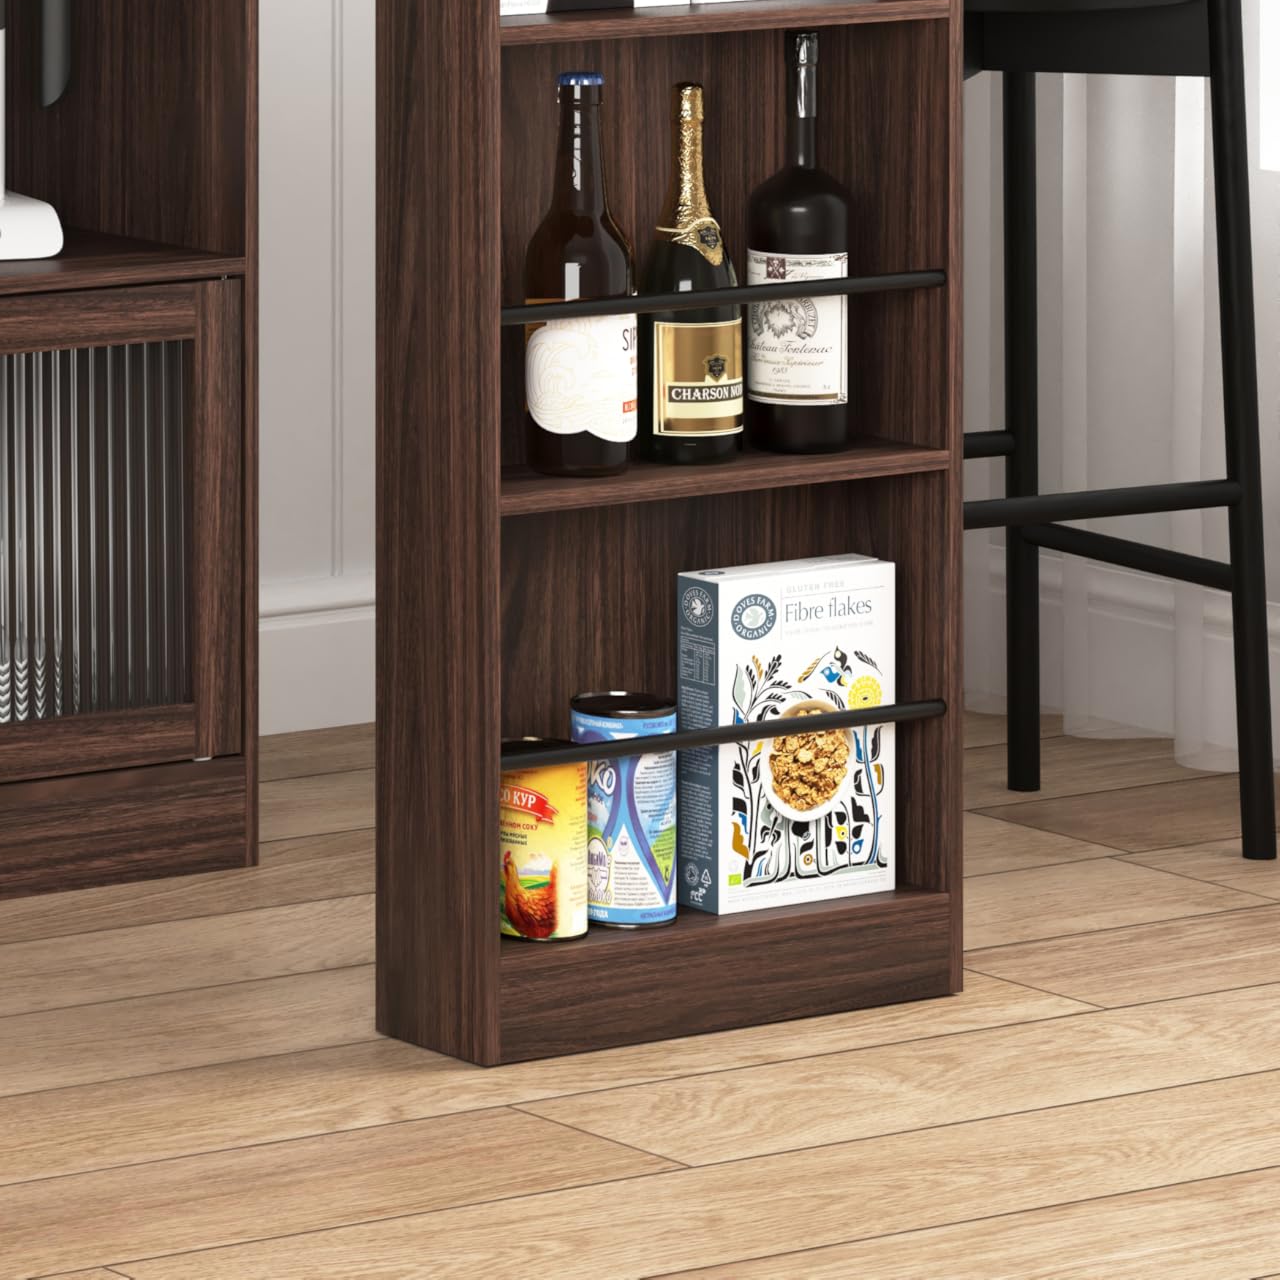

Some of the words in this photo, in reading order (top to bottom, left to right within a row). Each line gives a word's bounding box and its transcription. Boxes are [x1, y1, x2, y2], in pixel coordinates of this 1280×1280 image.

[671, 385, 730, 401] CHARSON
[733, 596, 755, 622] DOVES
[756, 596, 775, 617] FARM
[784, 600, 824, 623] Fibre
[829, 595, 873, 618] flakes
[735, 621, 773, 639] ORGANIC
[512, 790, 537, 809] КУР
